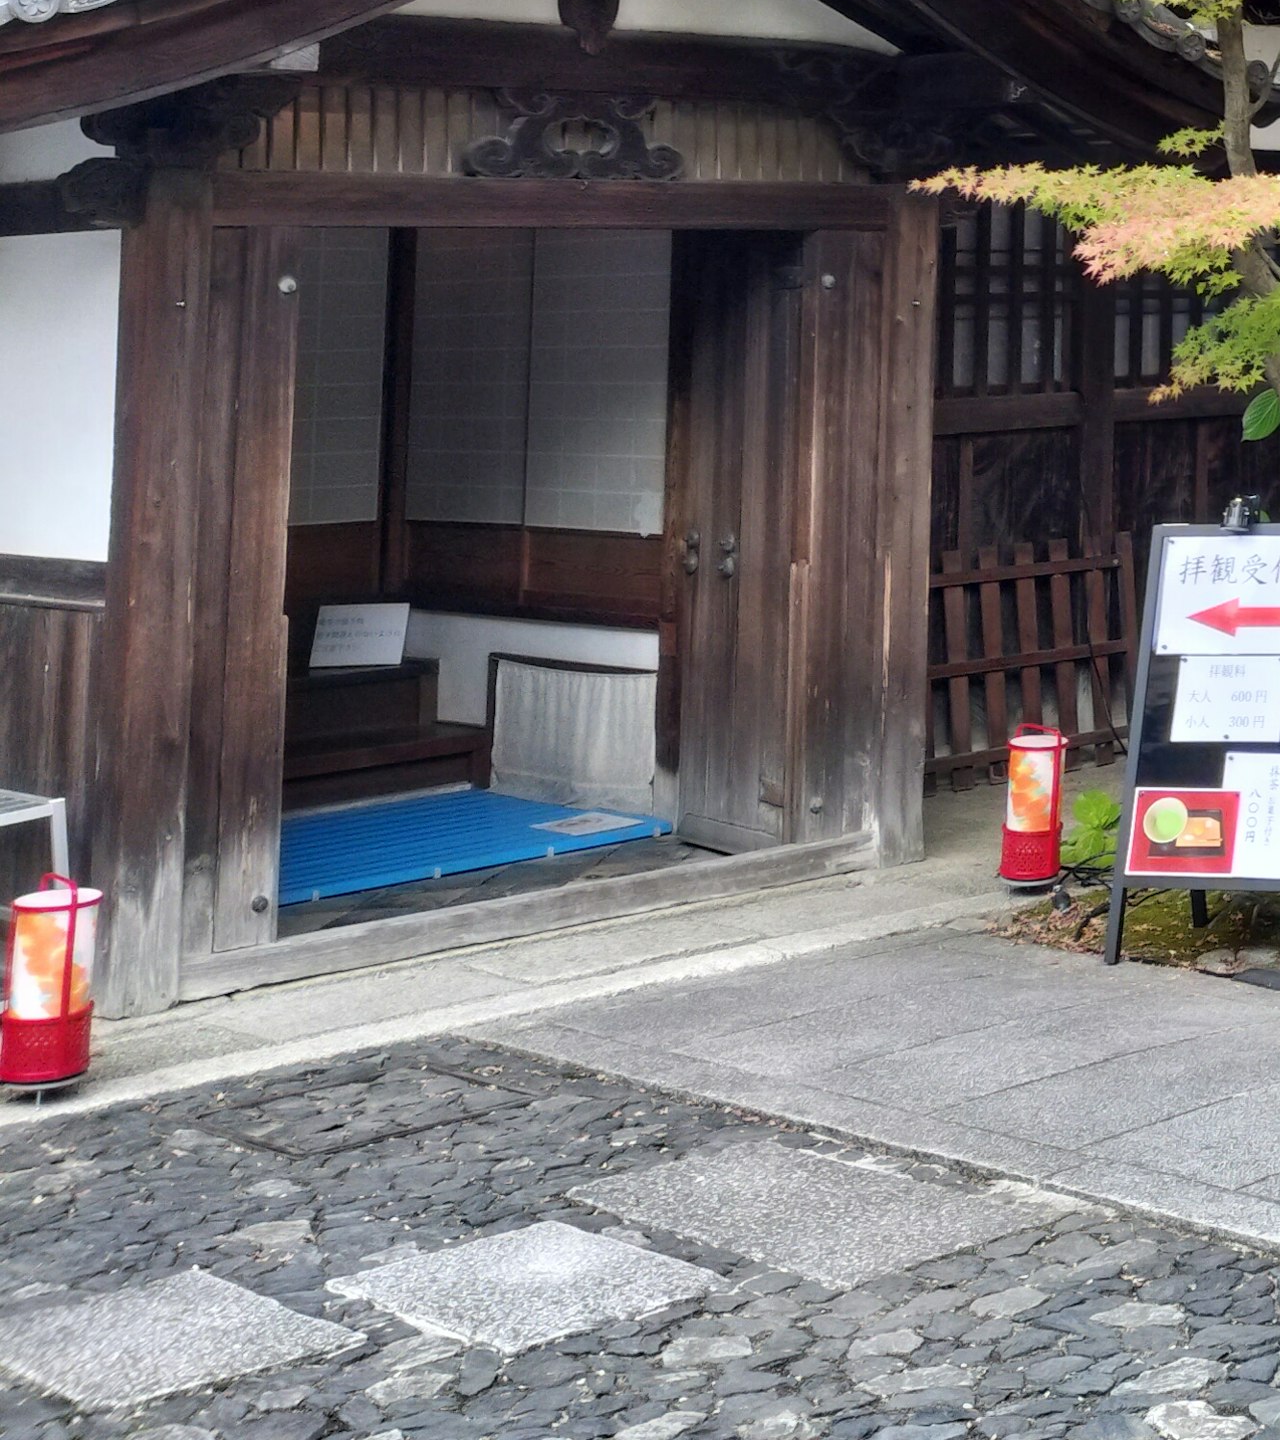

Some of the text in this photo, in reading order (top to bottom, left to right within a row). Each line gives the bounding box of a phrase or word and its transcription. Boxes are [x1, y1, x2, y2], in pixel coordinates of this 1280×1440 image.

[1209, 664, 1246, 679] 拝観料
[1187, 689, 1212, 703] 大人
[1184, 715, 1210, 729] 小人
